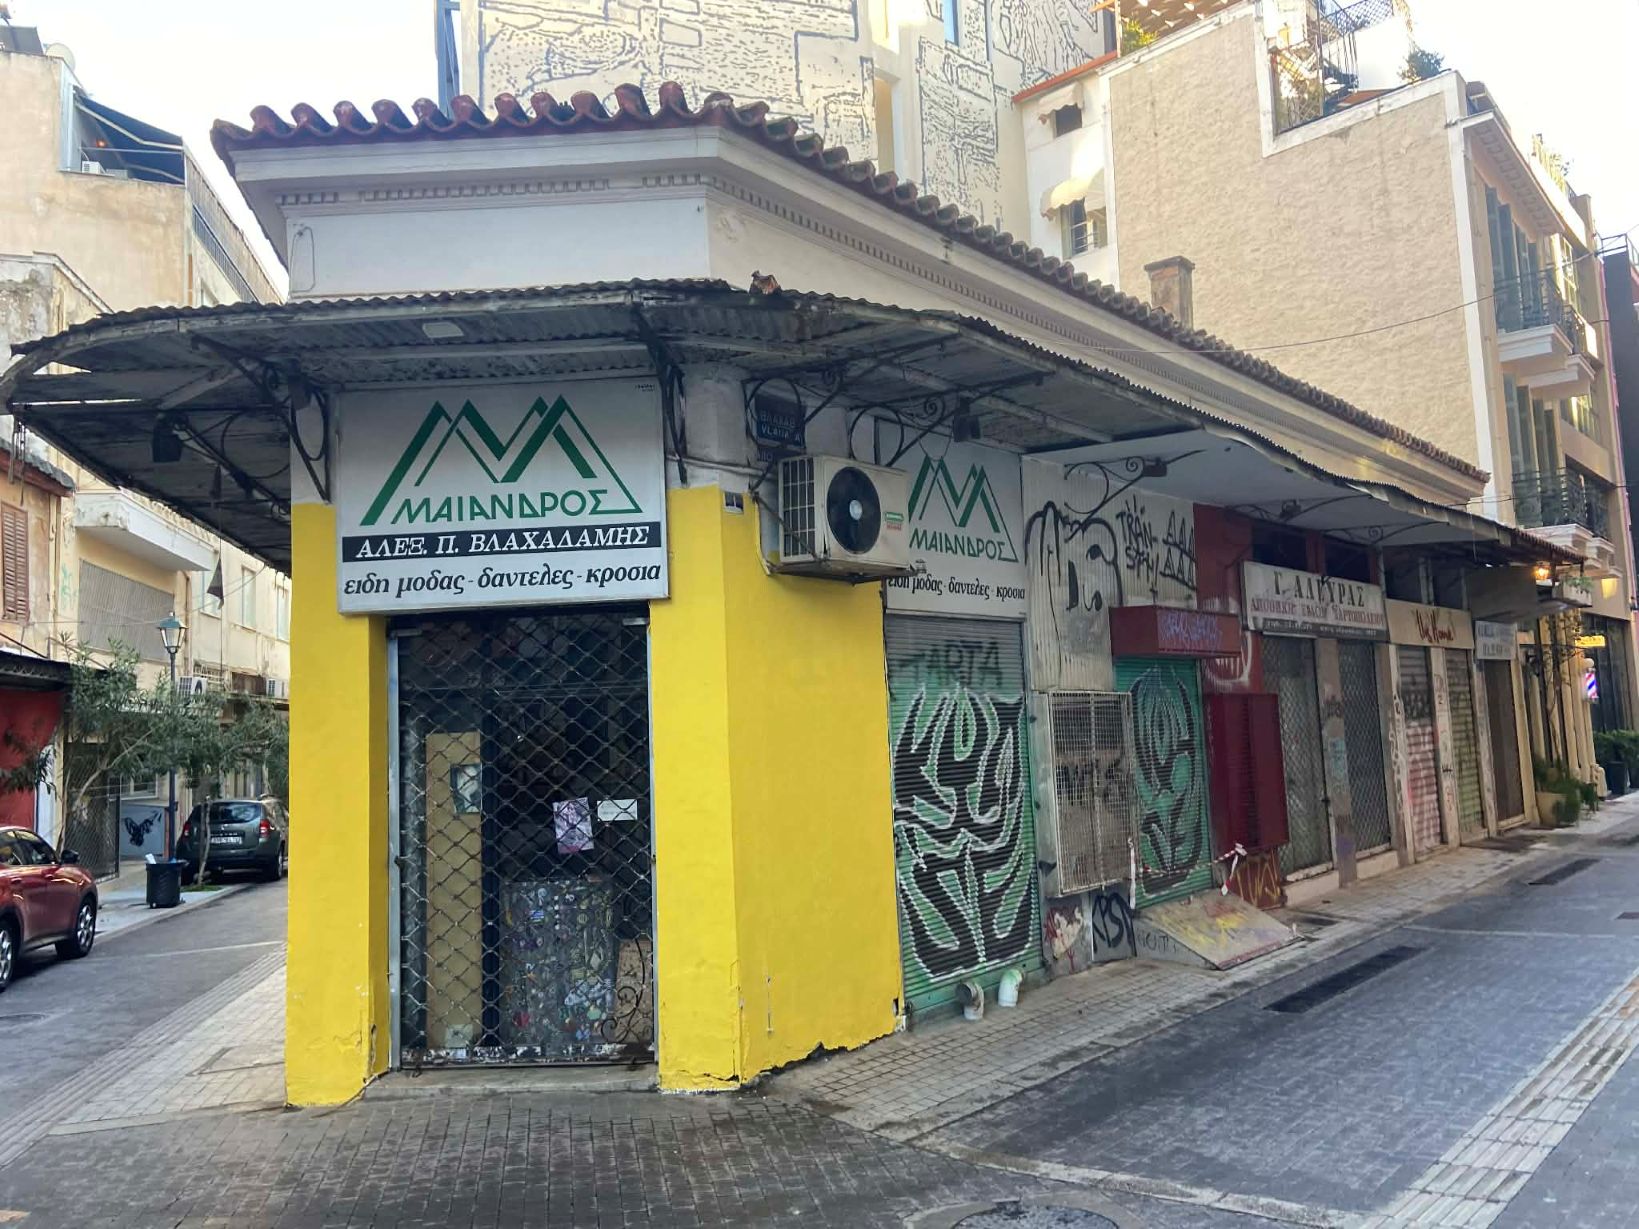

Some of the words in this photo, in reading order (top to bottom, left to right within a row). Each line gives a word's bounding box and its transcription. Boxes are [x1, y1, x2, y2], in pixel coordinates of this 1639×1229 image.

[391, 489, 642, 525] ΜΑΙΑΝΔΡΟΣ
[355, 536, 428, 558] ΑΛΕΞ.
[435, 535, 459, 554] Π.
[468, 525, 650, 553] ΒΛΑΧΑΔΑΜΗΣ
[909, 527, 1018, 563] ΜΑΙΑΝΔΡΟΣ
[343, 572, 390, 595] ειδη
[395, 569, 465, 598] μοδας
[477, 563, 574, 590] δαντελες
[586, 564, 661, 588] κροσια
[912, 573, 943, 597] μοδας
[948, 576, 990, 600] δαντελες
[996, 585, 1025, 602] κροσια
